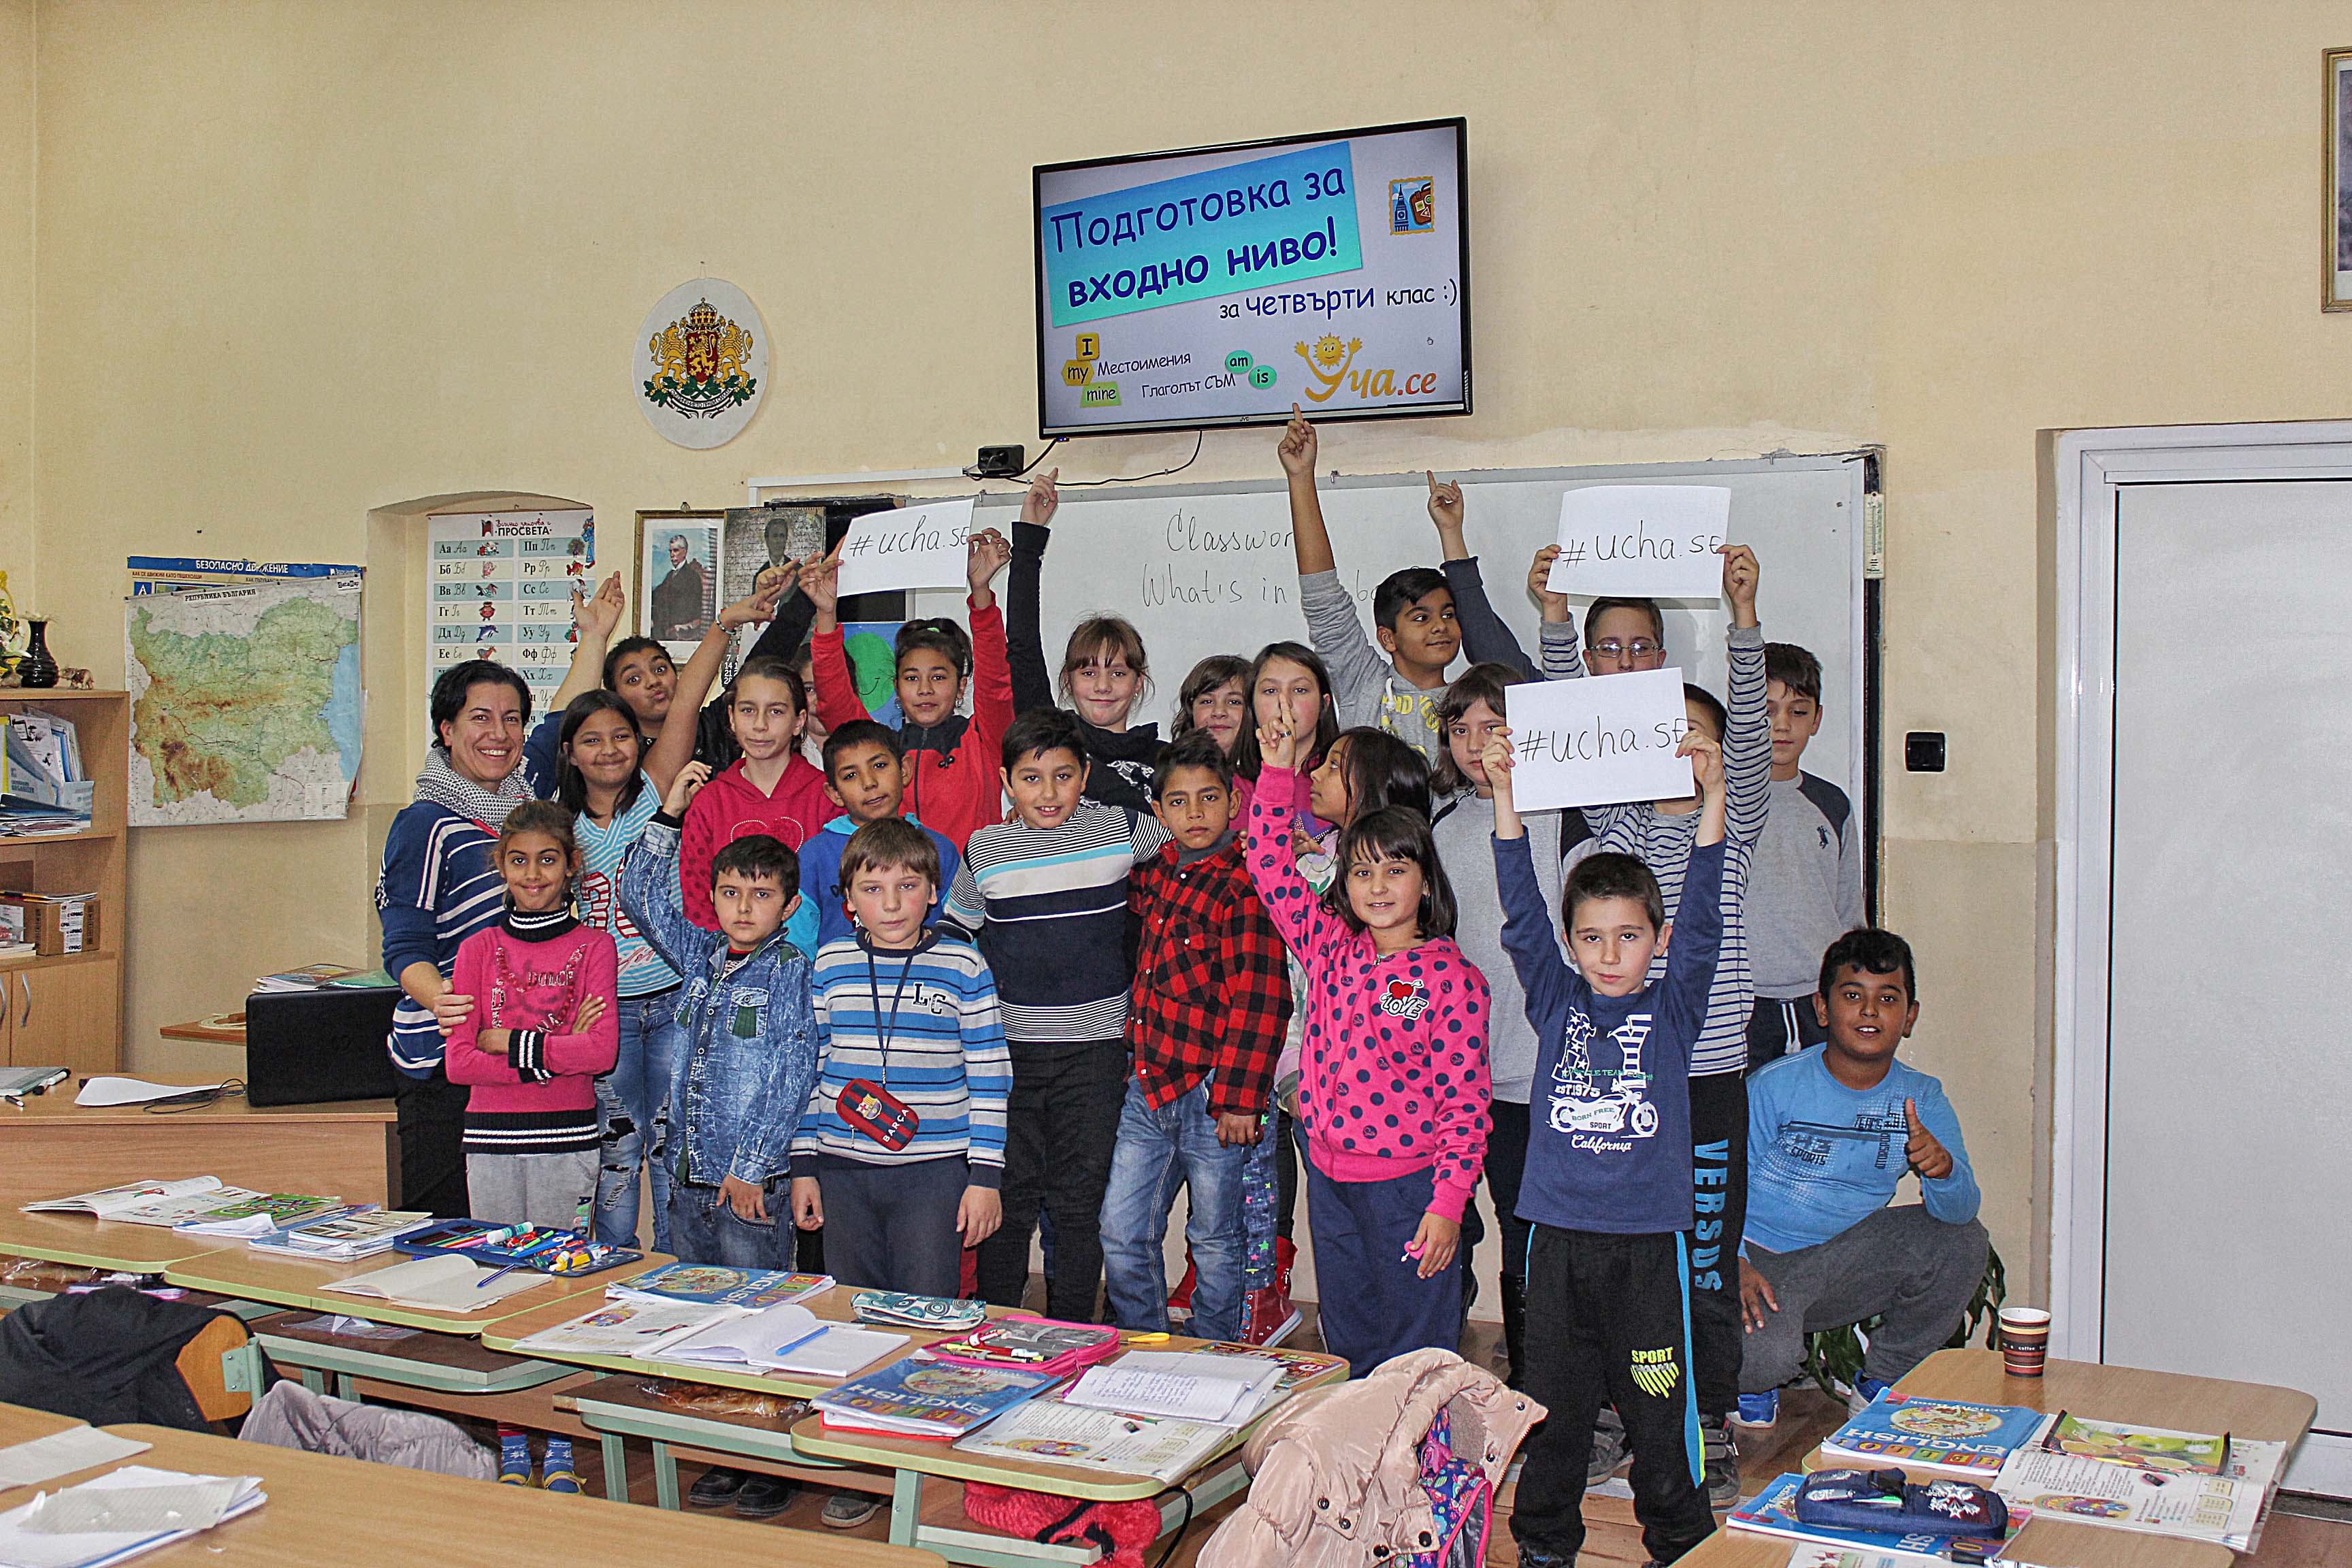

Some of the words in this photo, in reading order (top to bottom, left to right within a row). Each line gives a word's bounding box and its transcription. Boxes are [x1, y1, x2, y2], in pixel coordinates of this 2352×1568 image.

[1049, 179, 1290, 252] Подготовка
[1305, 167, 1345, 201] за
[1068, 255, 1209, 308] входно
[1227, 216, 1337, 276] ниво!
[1219, 303, 1240, 319] за
[1246, 287, 1374, 318] четвърти
[1386, 287, 1435, 306] клас
[1082, 338, 1093, 356] I
[1098, 353, 1191, 376] Местоимения
[1229, 357, 1248, 367] am
[1067, 366, 1089, 384] my
[1256, 368, 1268, 384] is
[1142, 380, 1200, 397] Глаголът
[1205, 374, 1236, 389] СЪМ
[1087, 386, 1117, 401] mine
[1166, 508, 1293, 553] Classwor
[439, 544, 451, 553] Аа
[524, 542, 538, 551] Пп
[196, 560, 244, 571] БЕЗОПАСНО
[246, 564, 289, 574] ДВЖЕНИЕ
[439, 564, 451, 574] Бб
[524, 563, 536, 575] Рр
[439, 586, 451, 595] Вв
[523, 584, 536, 593] Сс
[1143, 564, 1242, 606] What's
[1262, 578, 1288, 603] in
[185, 591, 221, 601] РЕПУБЛИКА
[223, 589, 256, 598] БЪЛГАРИЯ
[439, 607, 449, 617] Гг
[523, 606, 535, 615] Тт
[438, 627, 452, 638] Дд
[523, 627, 534, 640] Уу
[439, 649, 450, 659] Ее
[523, 649, 538, 661] Фф
[523, 670, 535, 680] Хх
[1382, 995, 1428, 1019] LOVE
[1571, 1112, 1592, 1122] BORN
[1594, 1107, 1615, 1116] FREE
[1571, 1134, 1632, 1154] California
[1791, 1146, 1828, 1166] SPORTS
[1691, 1139, 1729, 1290] VERSUS
[715, 1271, 789, 1305] NGLISH
[1631, 1346, 1673, 1364] SPORT
[847, 1384, 991, 1416] ENGLISH
[1844, 1428, 2008, 1455] ENGLISH
